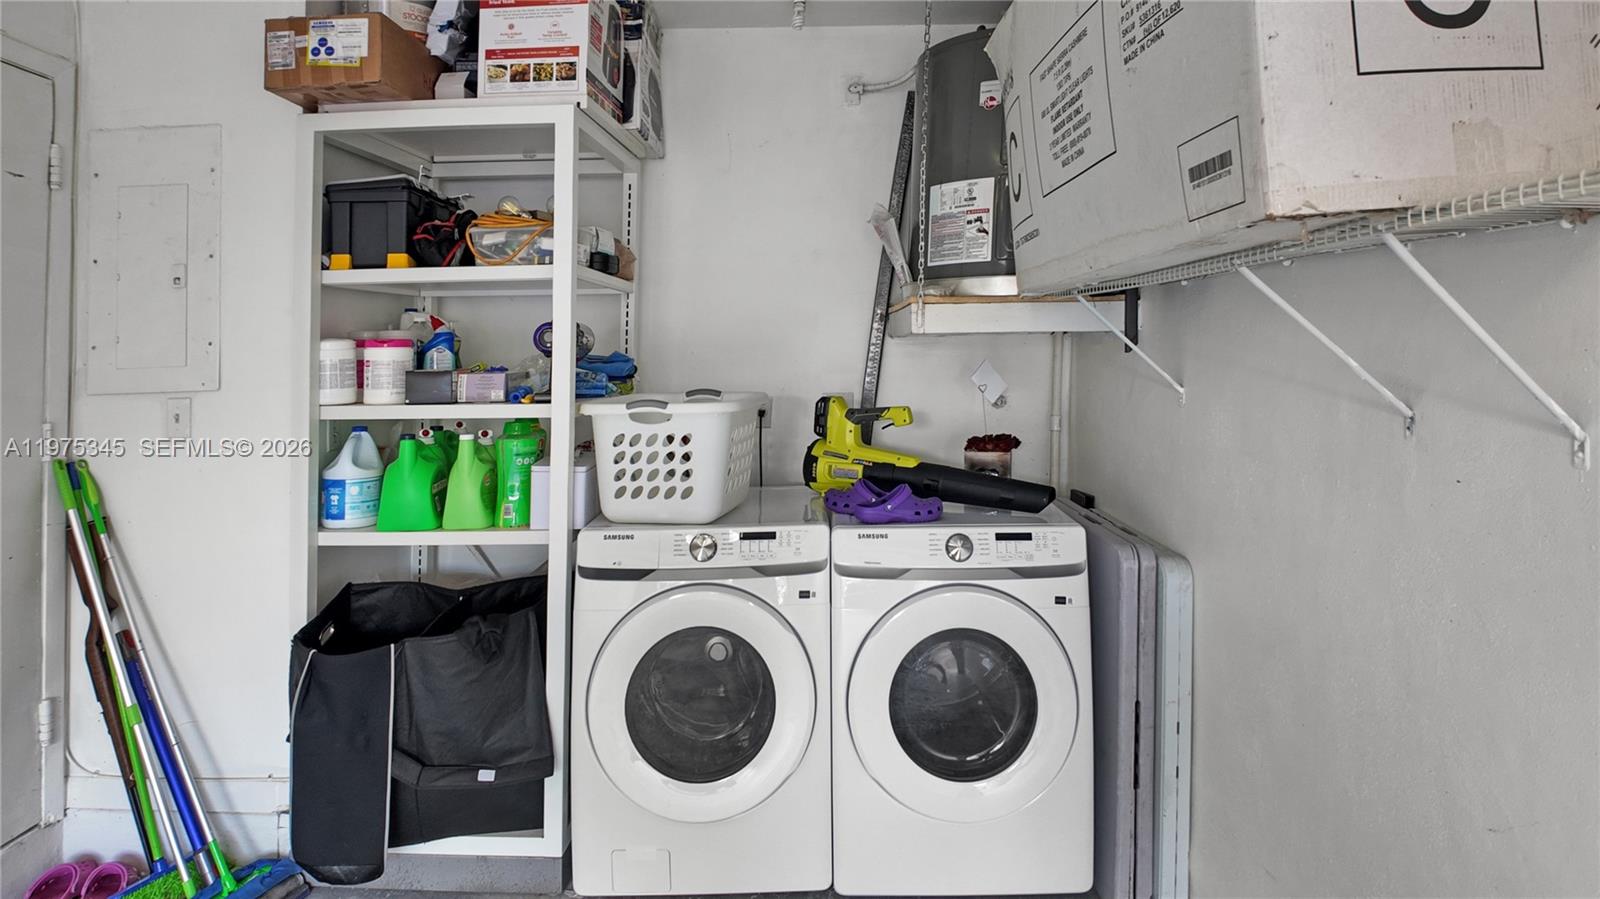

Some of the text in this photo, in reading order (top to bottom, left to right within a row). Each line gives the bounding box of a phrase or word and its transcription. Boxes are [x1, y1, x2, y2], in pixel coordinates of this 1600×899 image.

[1124, 29, 1165, 65] MADE IN CHINA
[1009, 131, 1021, 202] C
